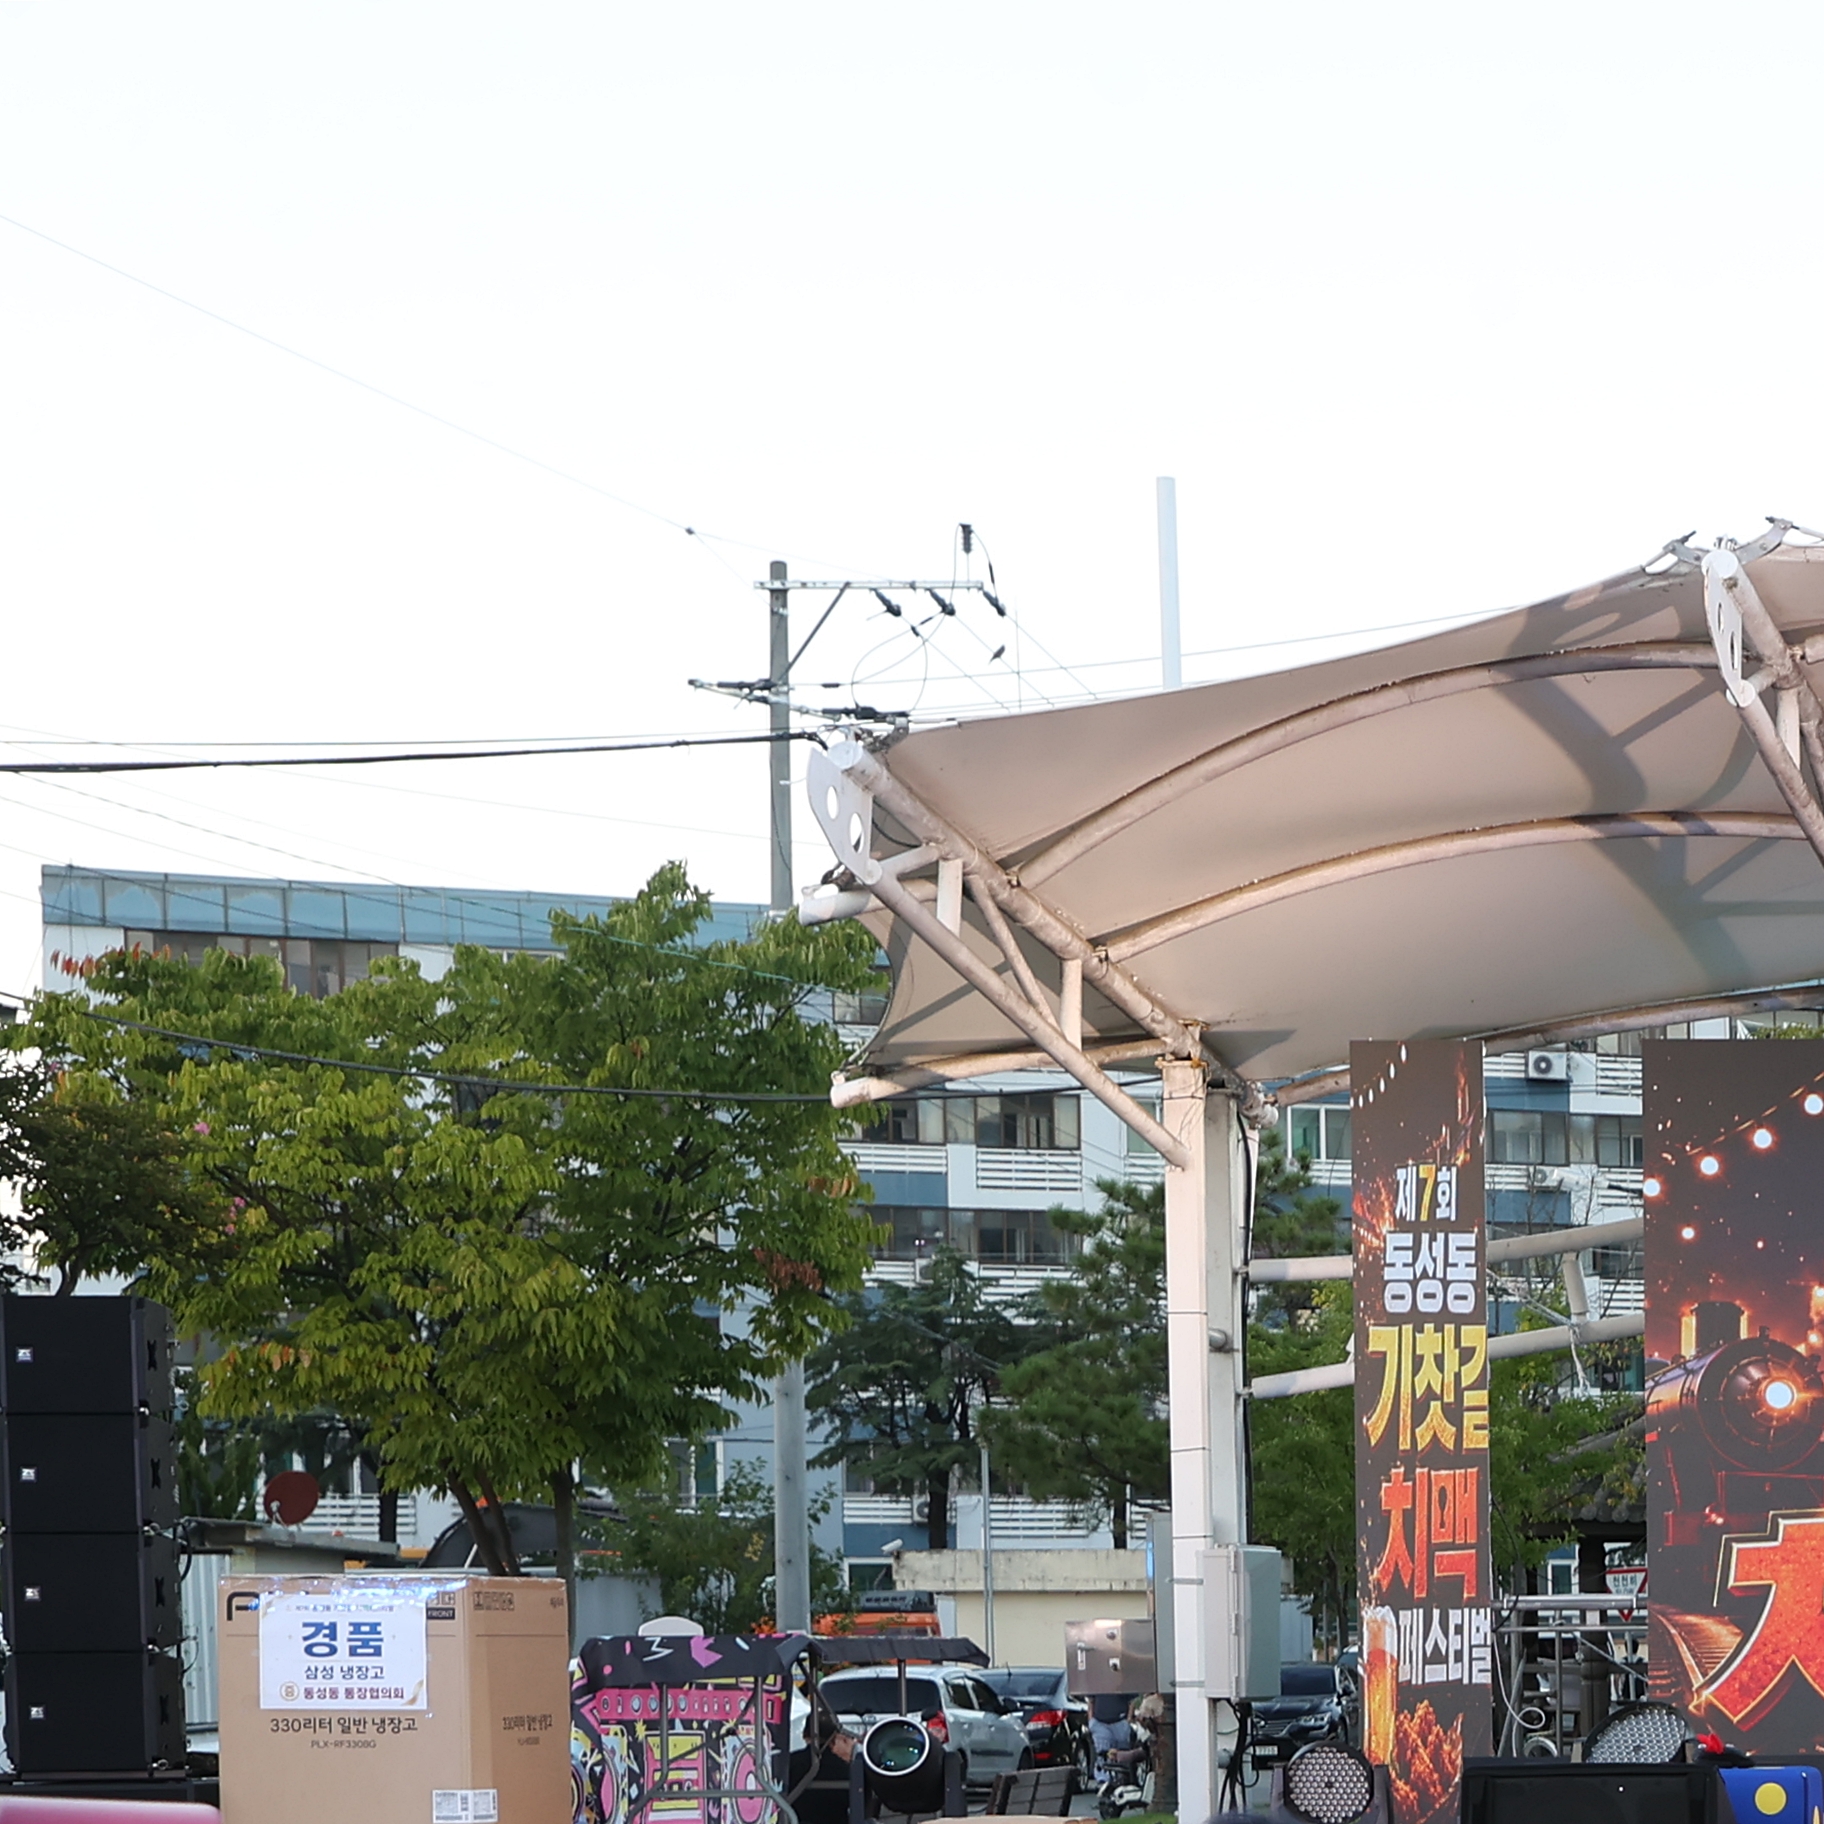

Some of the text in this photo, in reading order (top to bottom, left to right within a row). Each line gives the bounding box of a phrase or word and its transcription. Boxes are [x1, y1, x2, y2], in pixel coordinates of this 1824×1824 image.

[1396, 1164, 1456, 1221] 제7회
[1385, 1233, 1476, 1313] 동성동
[1374, 1467, 1478, 1599] 치맥
[302, 1621, 384, 1658] 경품
[1399, 1609, 1491, 1685] 페스티벌
[304, 1665, 384, 1680] 삼성 냉장고
[270, 1716, 418, 1734] 330리터 일반 냉장고
